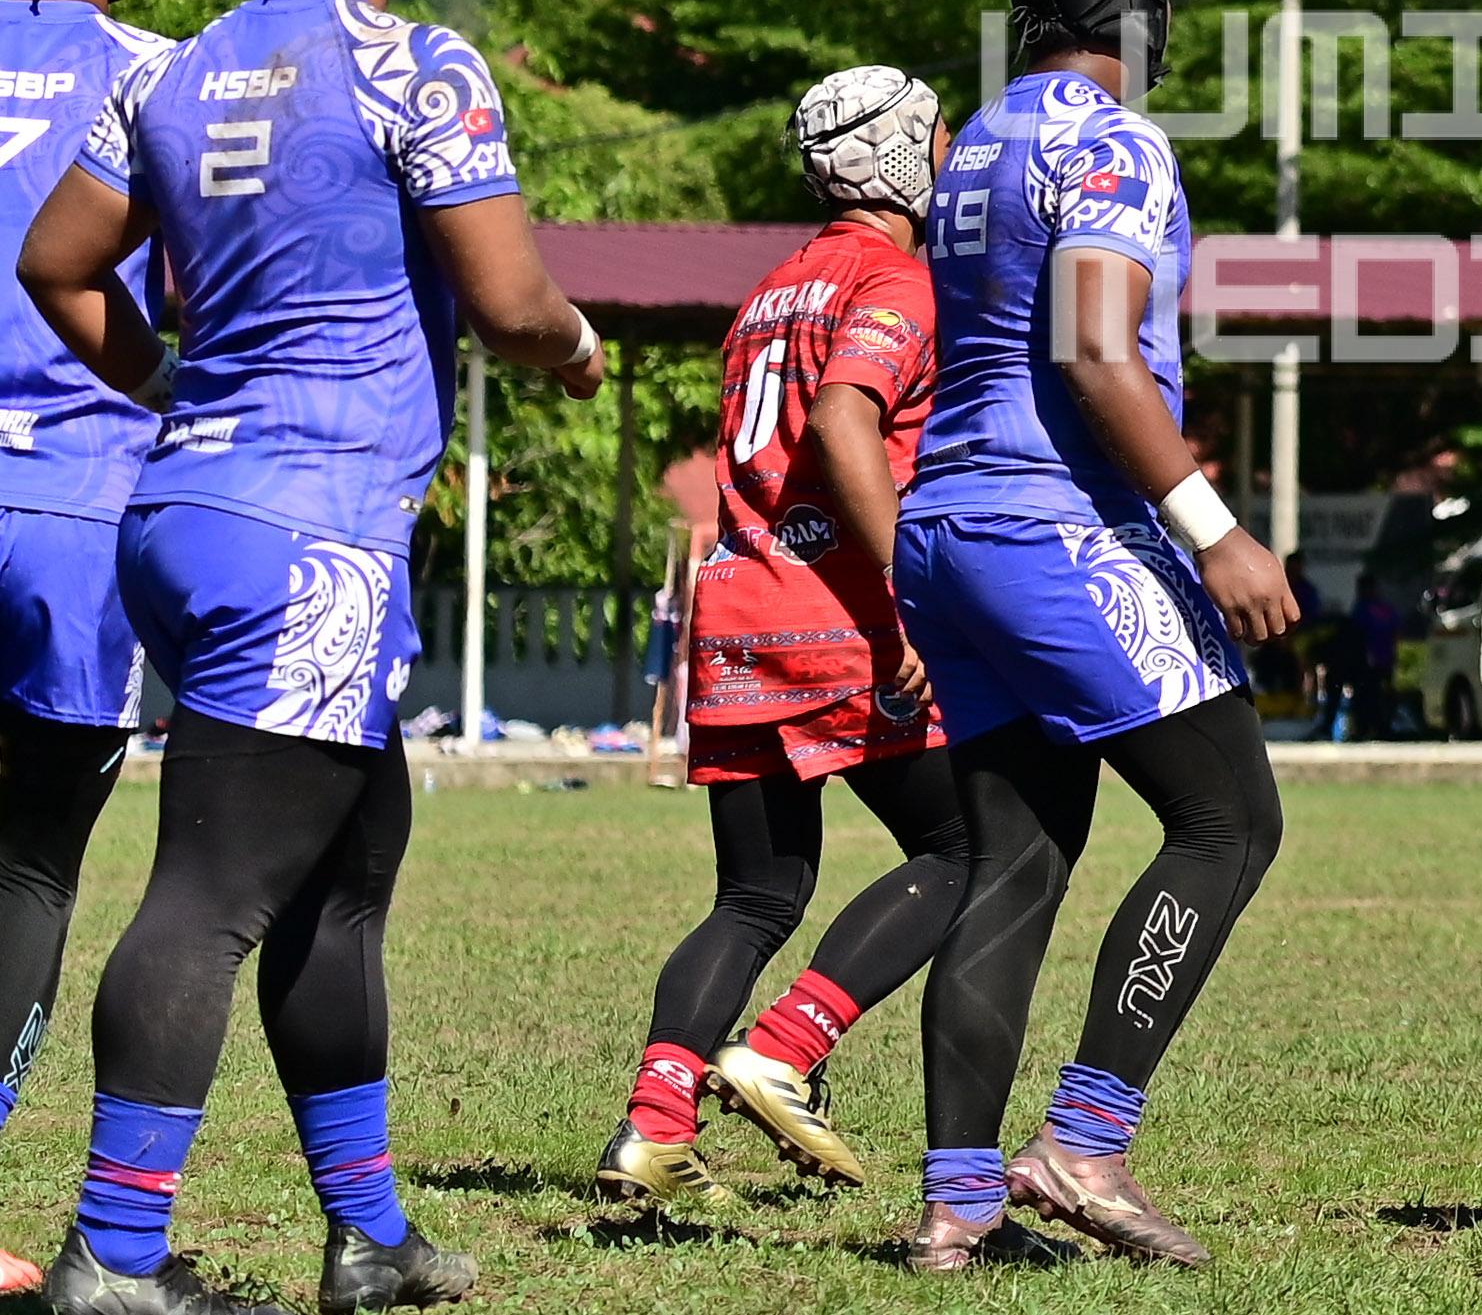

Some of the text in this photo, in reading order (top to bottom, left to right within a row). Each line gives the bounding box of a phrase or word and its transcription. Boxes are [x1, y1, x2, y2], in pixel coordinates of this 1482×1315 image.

[199, 66, 298, 101] HSBP
[199, 119, 273, 198] 2
[949, 141, 1003, 172] HSBP
[739, 279, 839, 329] AKRAM
[781, 520, 830, 547] BAM
[796, 1002, 840, 1042] AKR
